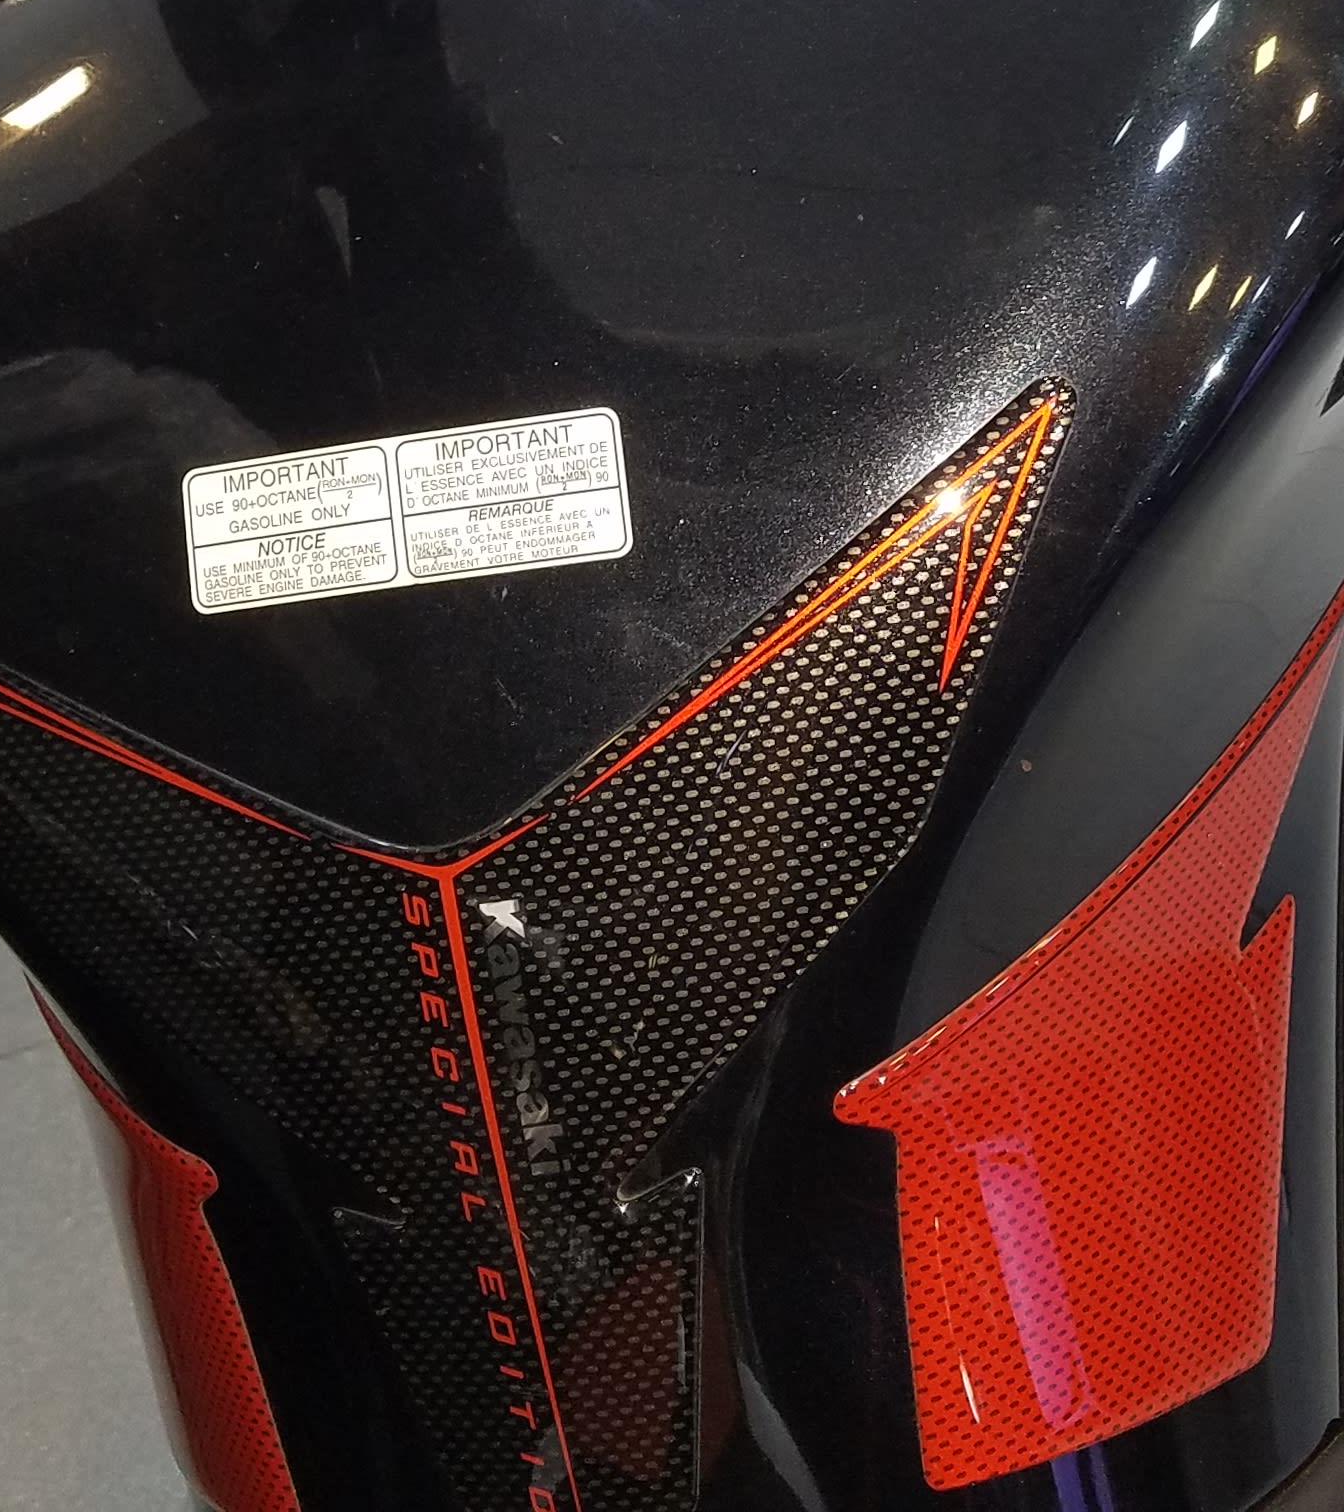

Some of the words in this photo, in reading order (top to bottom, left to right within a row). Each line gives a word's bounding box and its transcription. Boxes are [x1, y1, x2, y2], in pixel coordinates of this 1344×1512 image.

[436, 424, 572, 461] IMPORTANT
[224, 457, 348, 493] IMPORTANT
[405, 462, 463, 480] UTILISER
[472, 445, 584, 470] EXCLUSIVEMENT
[590, 441, 608, 453] DE
[421, 474, 483, 492] ESSENCE
[492, 467, 526, 482] AVEC
[535, 465, 554, 476] UN
[562, 456, 607, 471] INDICE
[423, 490, 469, 507] OCTANE
[477, 482, 528, 498] MINIMUM
[596, 472, 608, 482] 90
[196, 501, 224, 517] USE
[229, 511, 303, 533] GASOLINE
[311, 503, 350, 521] ONLY
[411, 527, 458, 542] UTILISER
[467, 525, 479, 534] DE
[501, 515, 551, 529] ESSENCE
[559, 510, 587, 521] AVEC
[595, 508, 610, 516] UN
[469, 499, 554, 522] REMARQUE
[258, 533, 326, 557] NOTICE
[470, 531, 512, 545] OCTANE
[480, 544, 507, 554] PEUT
[516, 531, 596, 549] ENDOMMAGER
[204, 565, 226, 577] USE
[233, 557, 285, 574] MINIMUM
[292, 554, 307, 564] OF
[311, 542, 382, 561] 90+OCTANE
[205, 572, 263, 590] GASOLINE
[270, 566, 300, 580] ONLY
[307, 564, 323, 575] TO
[331, 554, 387, 572] PREVENT
[414, 558, 478, 574] GRAVEMENT
[487, 550, 524, 565] VOTRE
[531, 545, 578, 558] MOTEUR
[206, 587, 252, 602] SEVERE
[259, 579, 304, 595] ENGINE
[478, 898, 571, 1177] Kawasaki
[402, 892, 487, 1223] SPECIAL
